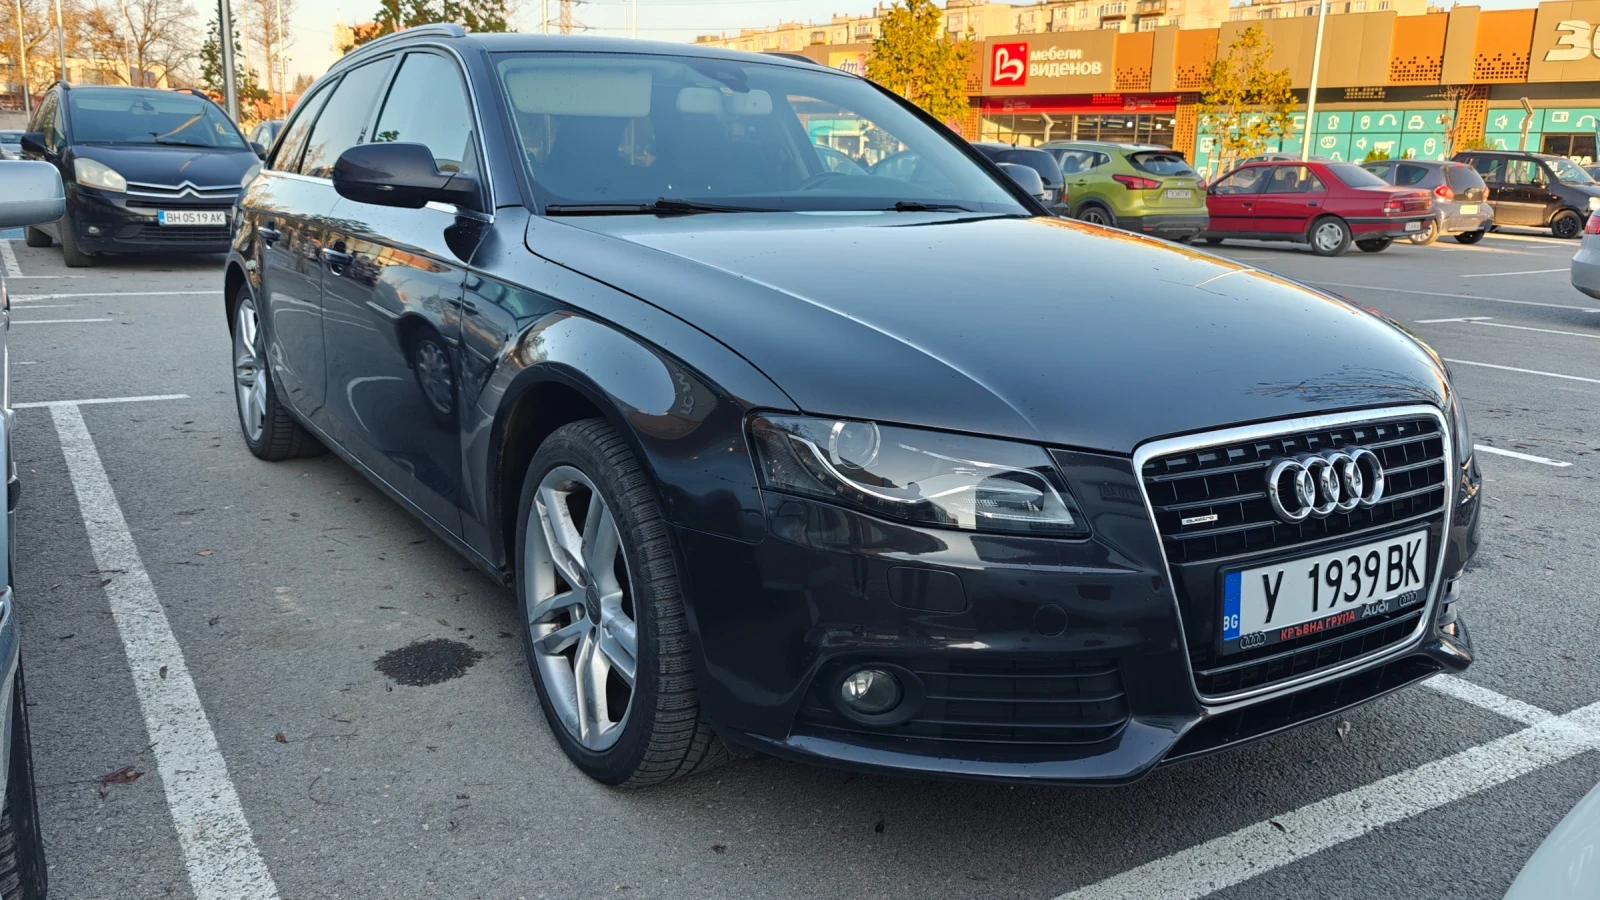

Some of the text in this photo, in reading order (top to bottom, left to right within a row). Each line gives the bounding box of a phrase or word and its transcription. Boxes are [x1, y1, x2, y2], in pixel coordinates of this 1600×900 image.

[1030, 46, 1083, 61] мебели
[840, 59, 859, 73] dm
[166, 212, 224, 223] BH 0519 AK
[1362, 600, 1389, 618] Audi
[1223, 614, 1239, 631] BG
[1281, 611, 1355, 640] КРЪВНА ГРУПА
